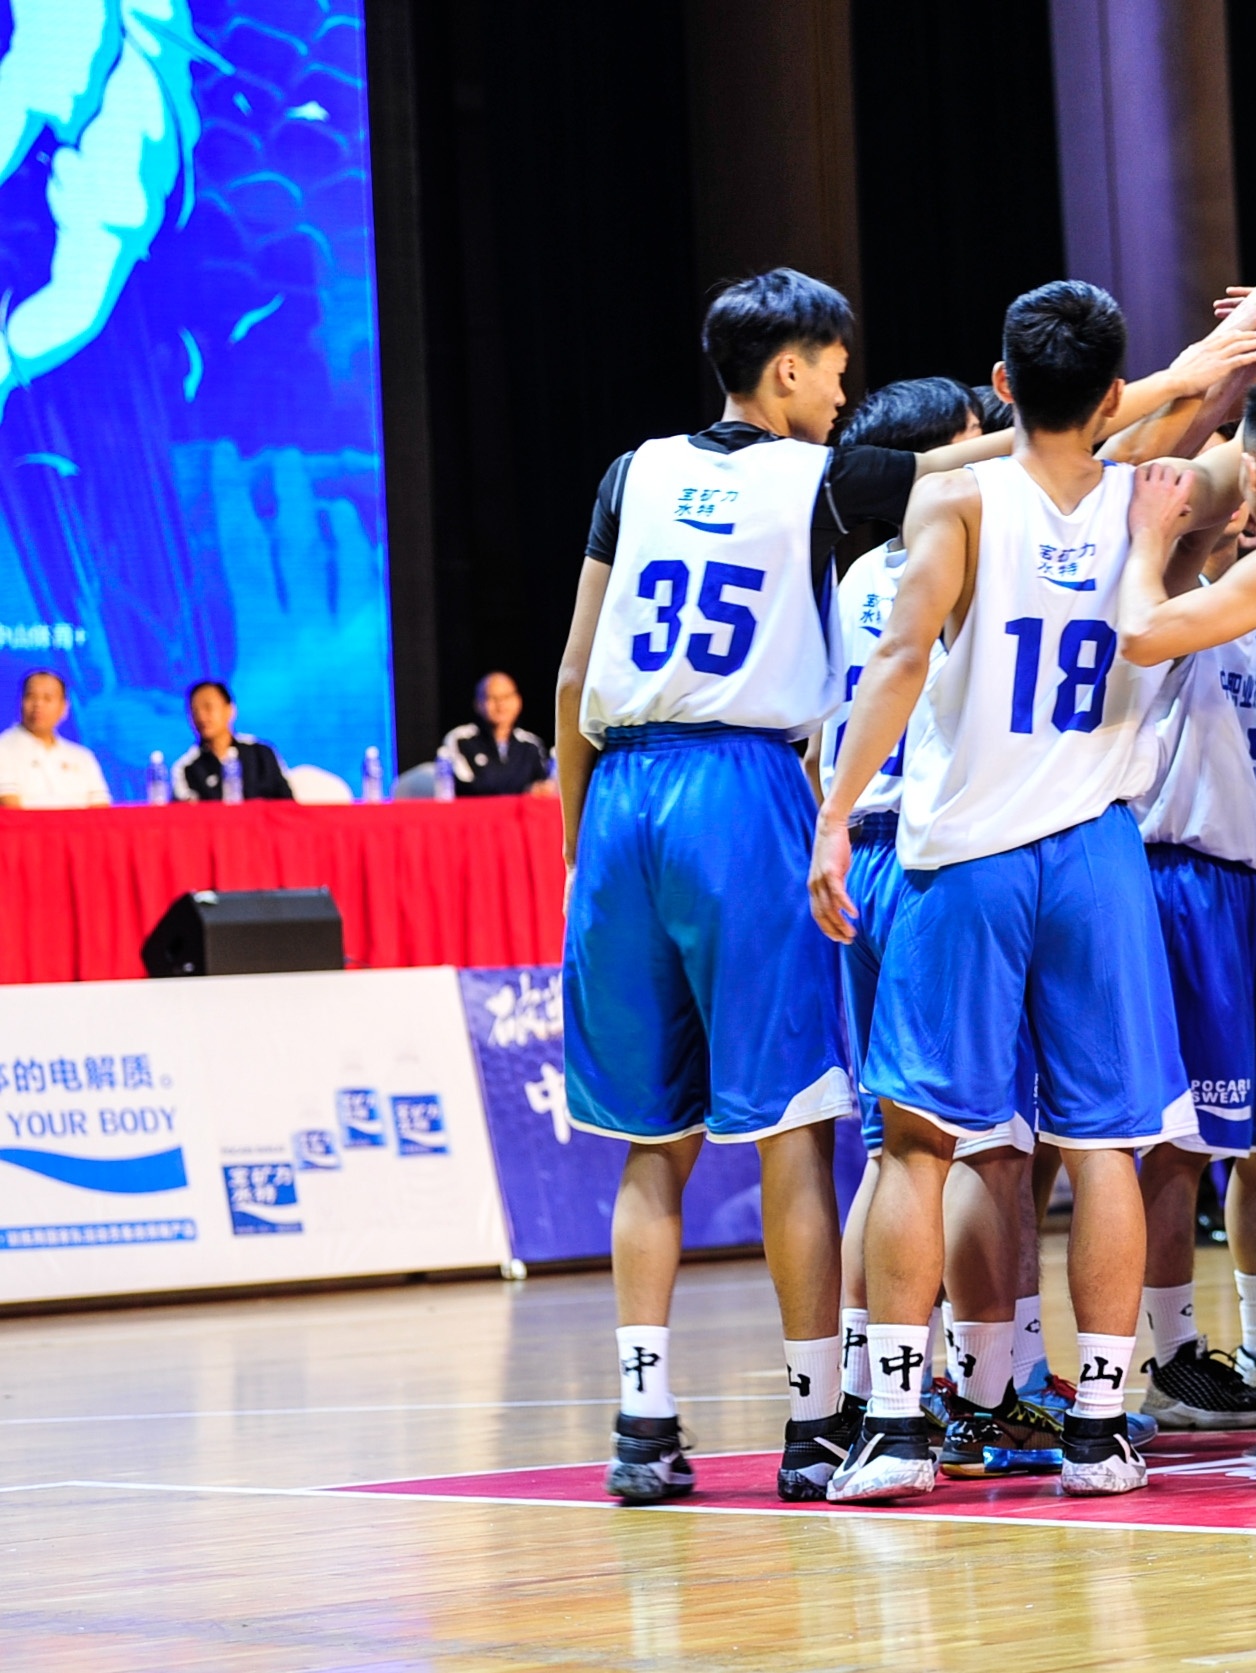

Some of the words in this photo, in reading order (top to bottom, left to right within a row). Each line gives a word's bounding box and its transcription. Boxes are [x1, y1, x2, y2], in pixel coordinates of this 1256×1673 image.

[674, 503, 715, 518] 水特
[677, 487, 739, 502] 宝矿力
[1037, 561, 1077, 577] 水特
[1038, 543, 1095, 562] 宝矿力
[631, 559, 765, 675] 35
[1005, 617, 1117, 734] 18
[0, 1053, 173, 1094] 的电解质。
[1191, 1079, 1251, 1093] POCARI
[1192, 1091, 1247, 1104] SWEAT
[7, 1110, 88, 1139] YOUR
[99, 1106, 176, 1135] BODY
[621, 1346, 661, 1393] 中
[879, 1345, 924, 1392] 中
[1081, 1355, 1124, 1391] 山
